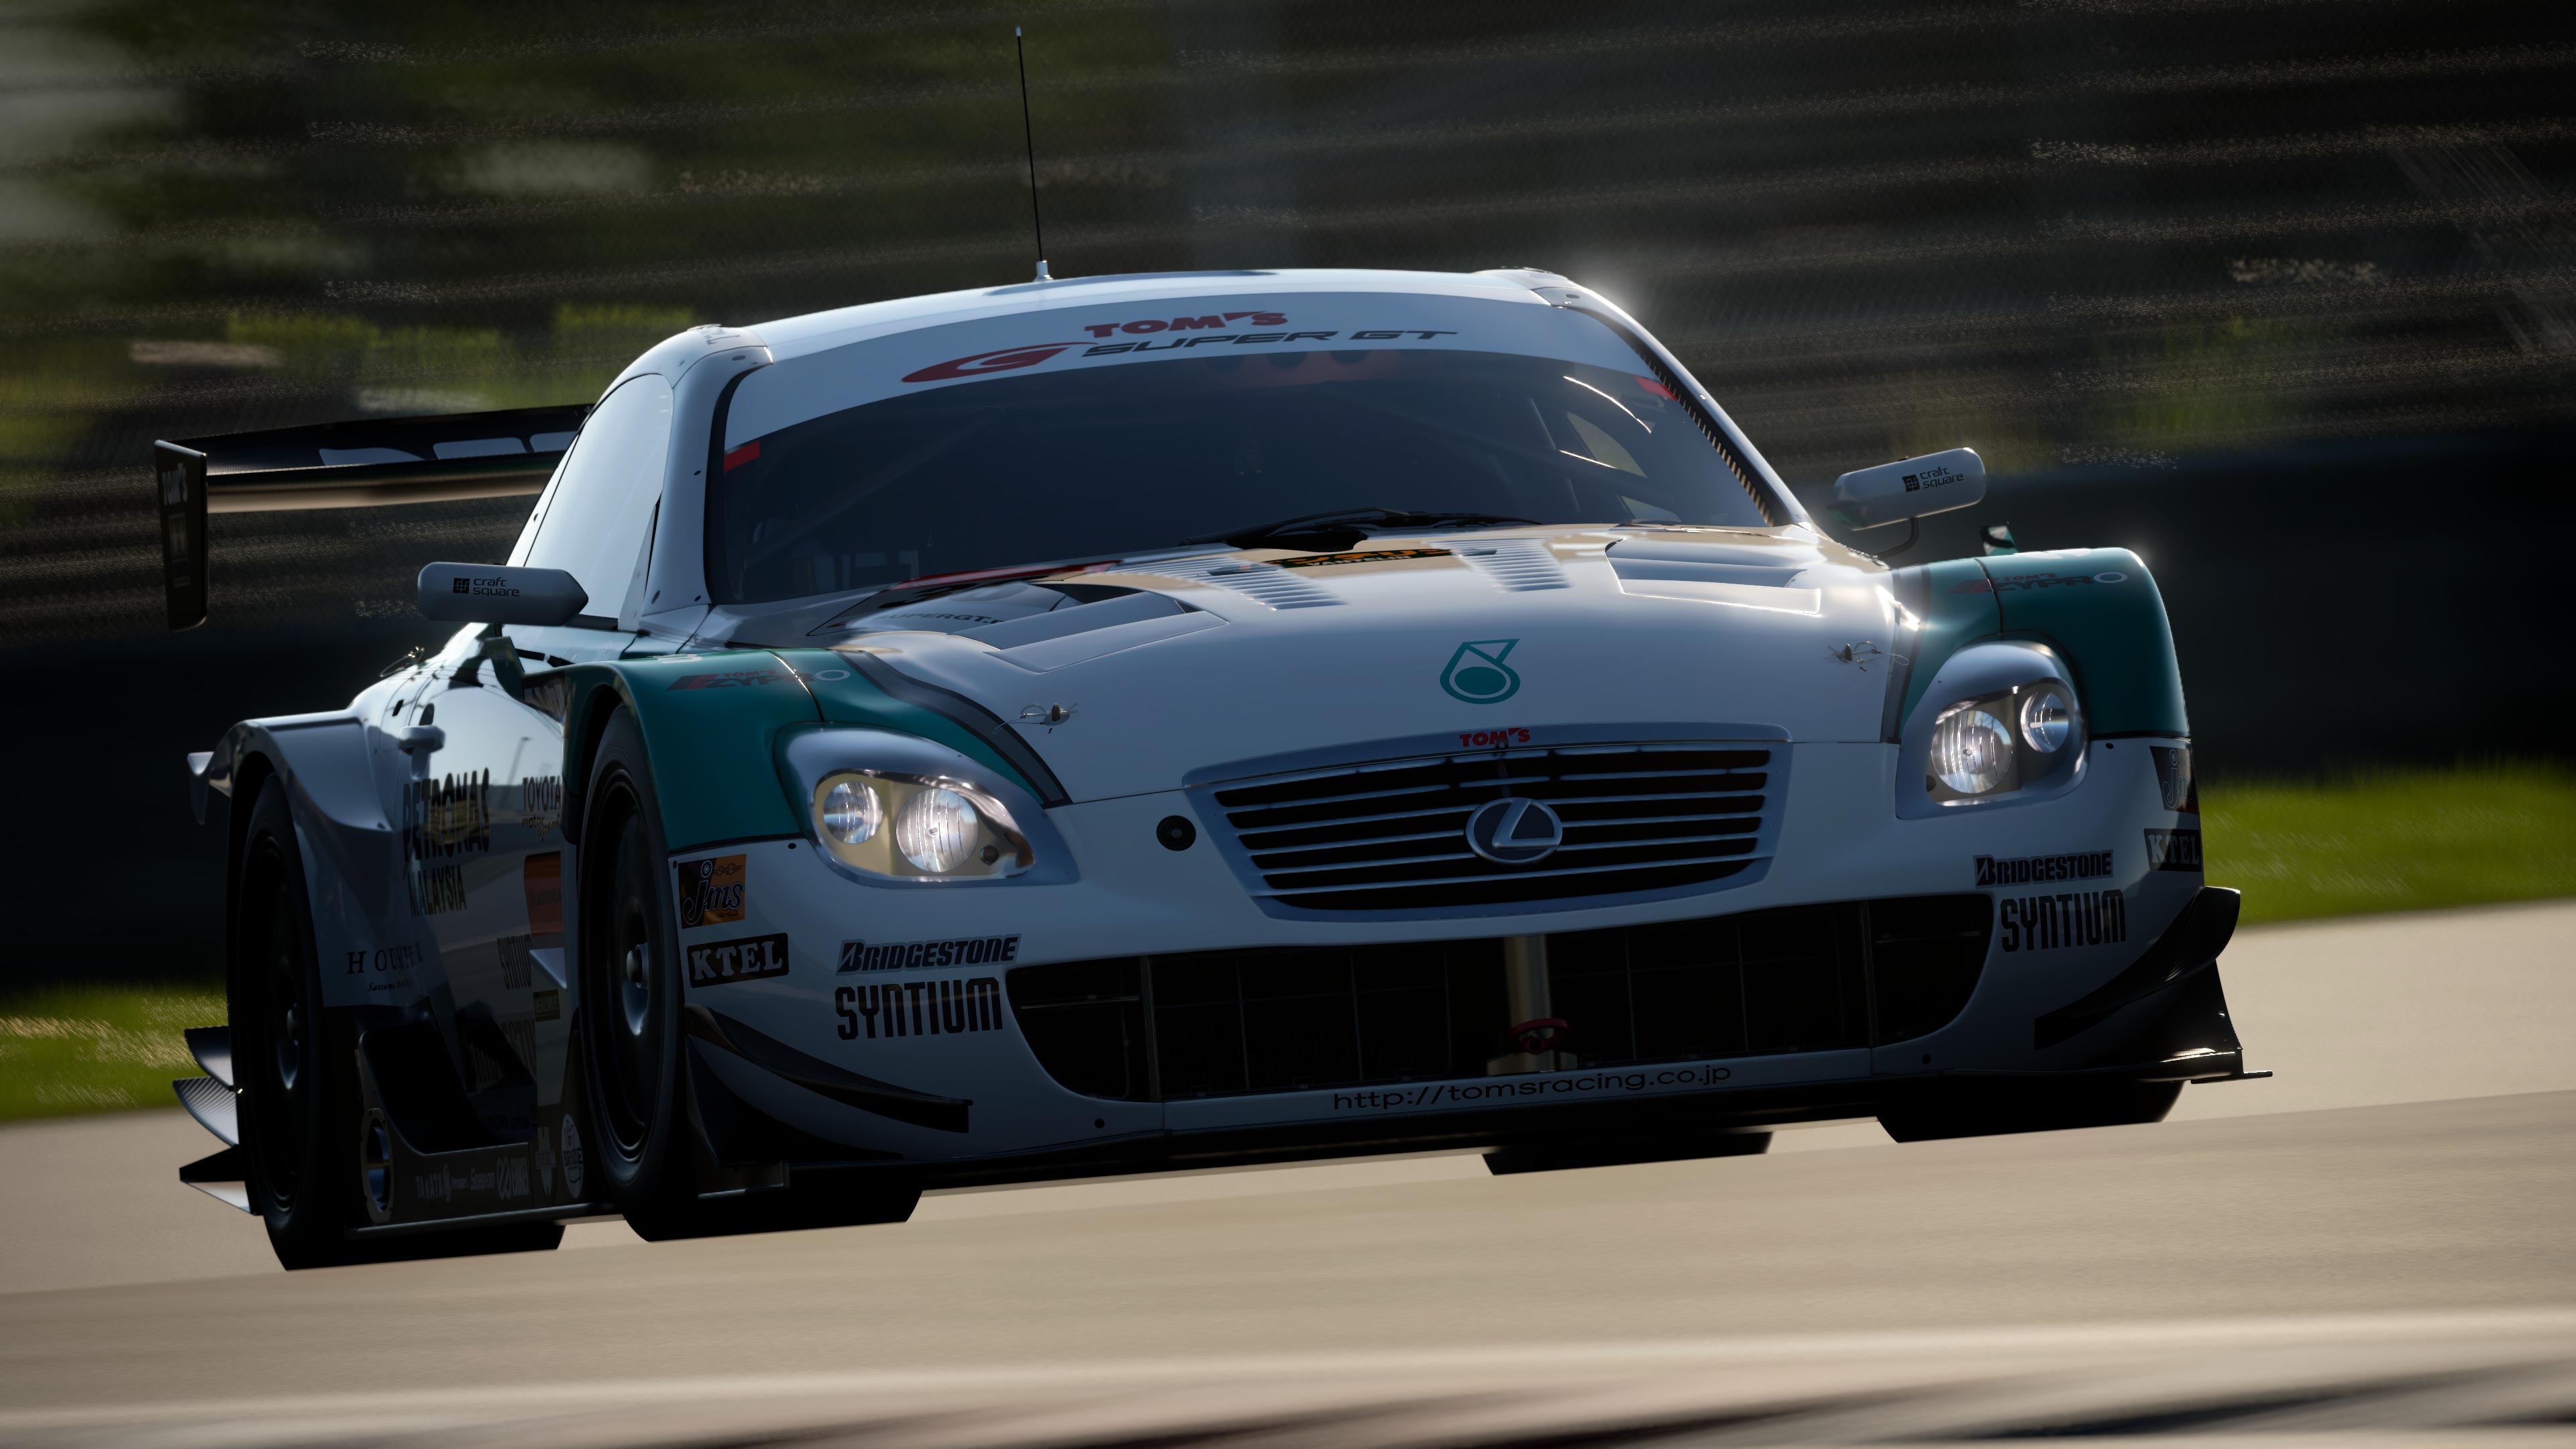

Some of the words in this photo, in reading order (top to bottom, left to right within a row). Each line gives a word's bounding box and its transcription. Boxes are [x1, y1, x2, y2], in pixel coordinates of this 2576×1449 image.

[1084, 311, 1288, 338] TOM'S
[1081, 331, 1338, 358] SUPER
[1350, 330, 1458, 340] GT
[1923, 472, 1964, 489] square
[1306, 555, 1412, 566] VANTELIN
[472, 586, 520, 598] square
[1459, 728, 1530, 747] TOM'S
[523, 775, 561, 812] TOYOTA
[402, 767, 490, 862] PETRONAS
[2147, 835, 2201, 866] KTEL
[1976, 853, 2112, 886] BRIDGESTONE
[408, 865, 468, 918] MALAYSIA
[2000, 890, 2126, 952] SYNTIUM
[690, 941, 784, 982] KTEL
[837, 936, 1019, 973] BRIDGESTONE
[835, 977, 1004, 1040] SYNTIUM
[1334, 1065, 1731, 1110] http://tomsracing.co.jp
